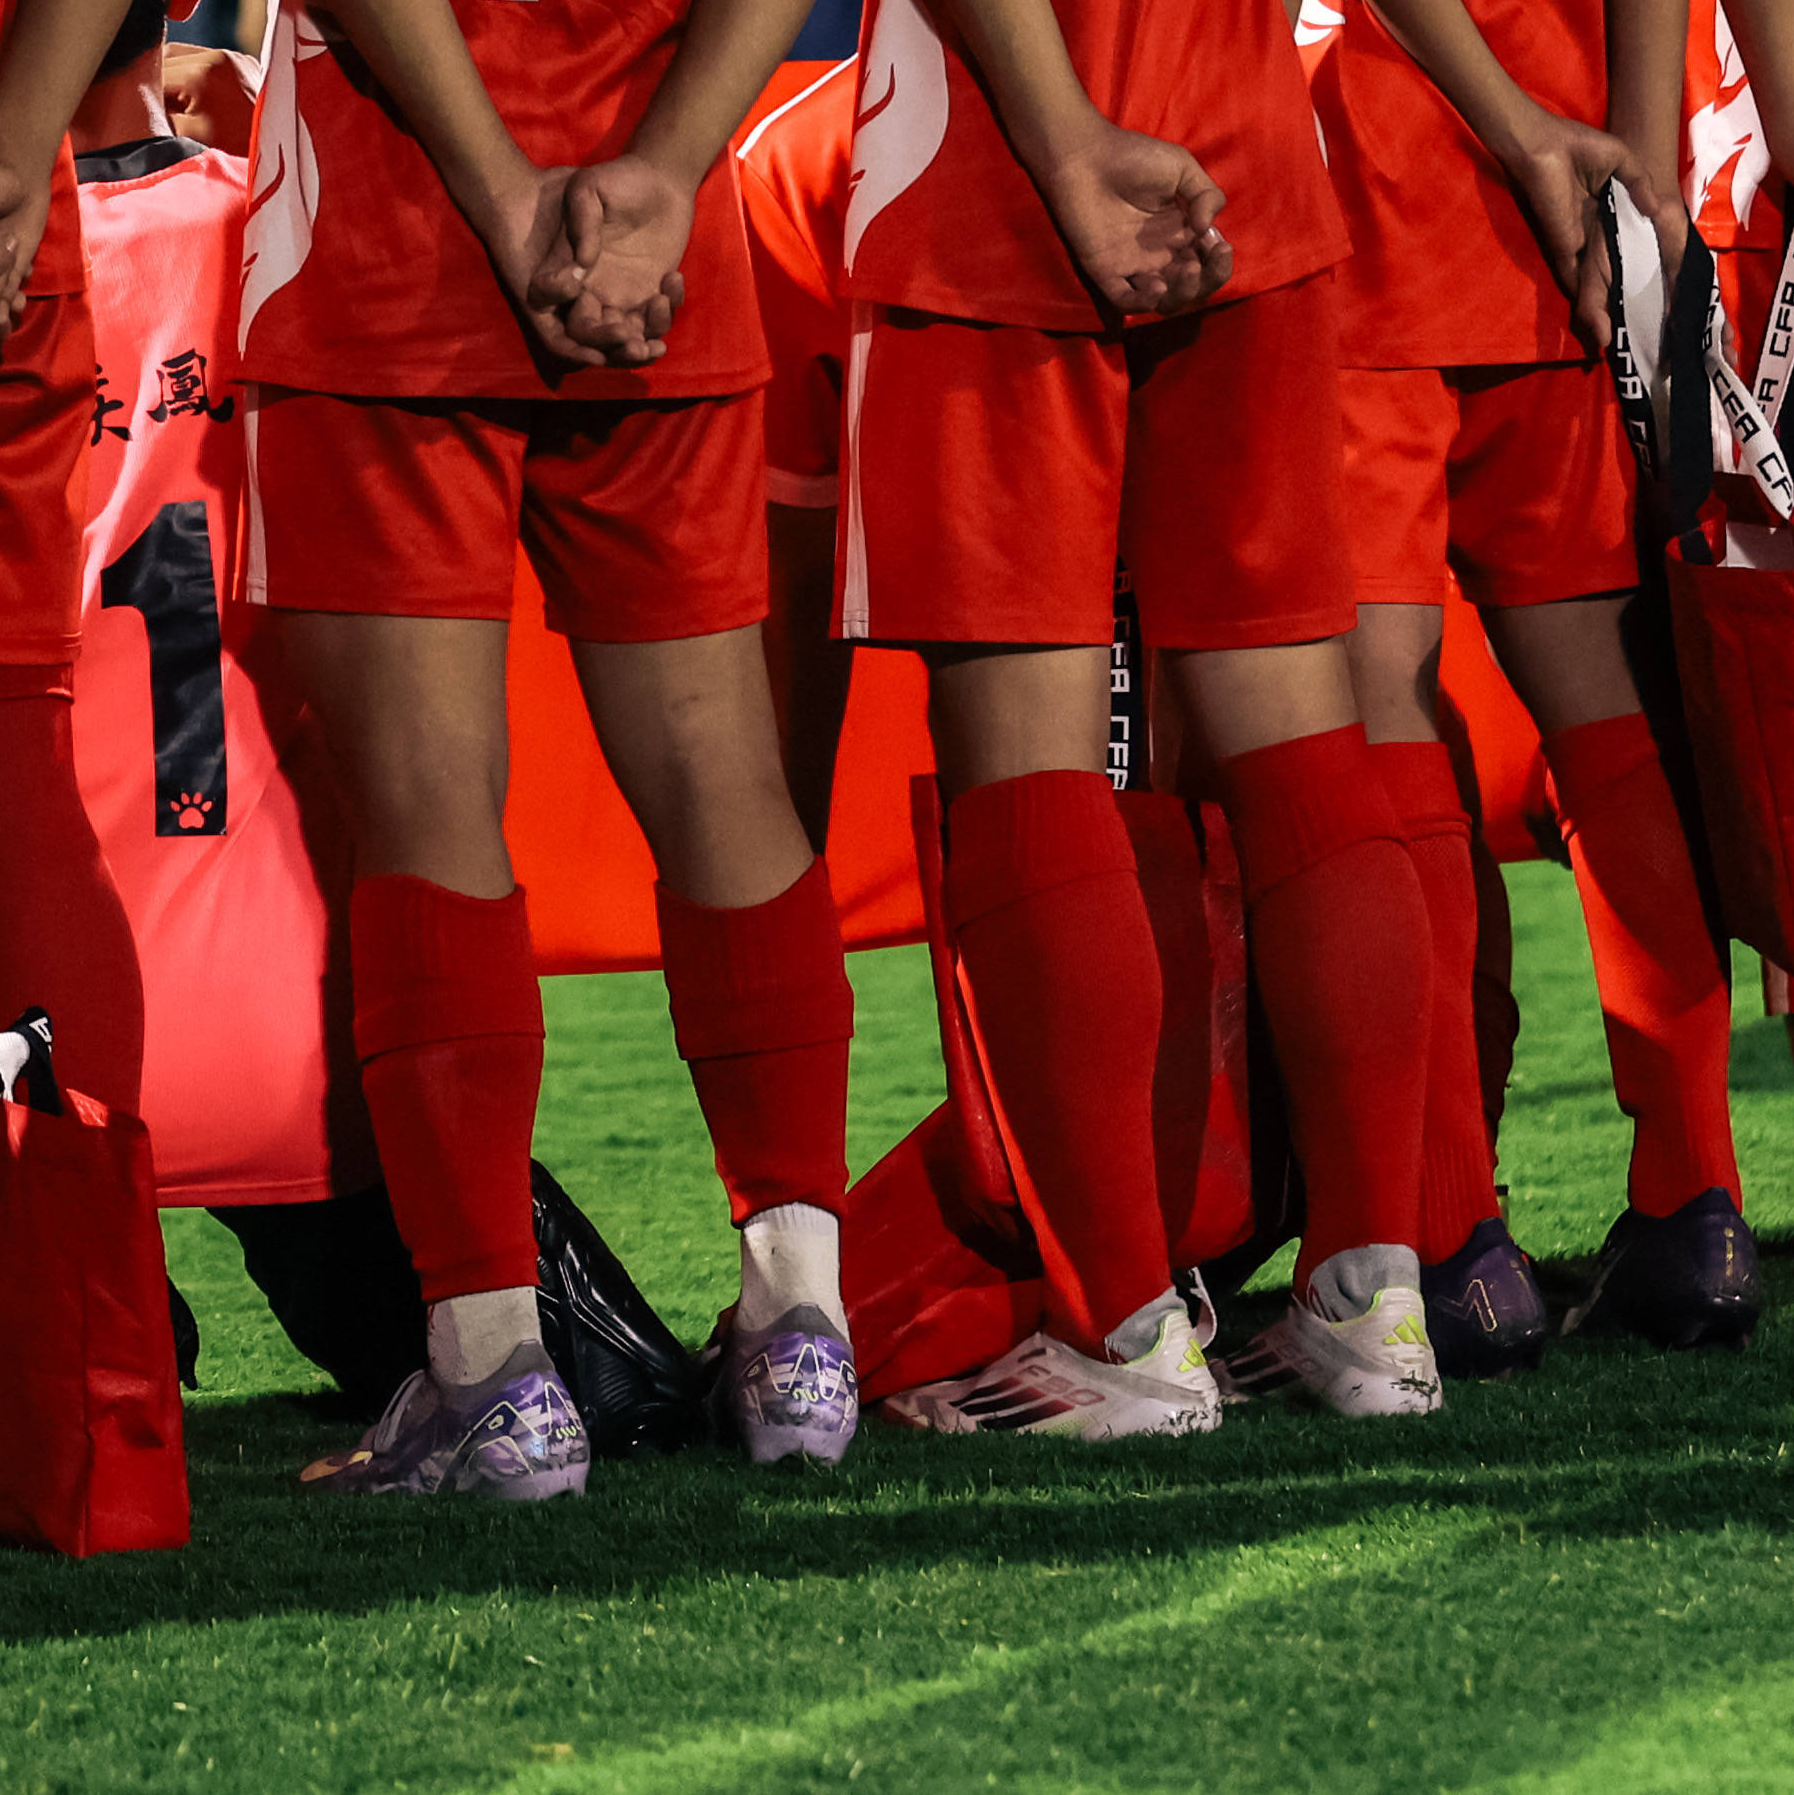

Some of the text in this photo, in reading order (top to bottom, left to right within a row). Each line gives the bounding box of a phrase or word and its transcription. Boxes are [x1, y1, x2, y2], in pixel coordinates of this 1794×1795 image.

[1615, 325, 1644, 401] CFA
[1712, 368, 1761, 445] CFA
[1755, 451, 1794, 512] CF
[100, 500, 229, 836] 1
